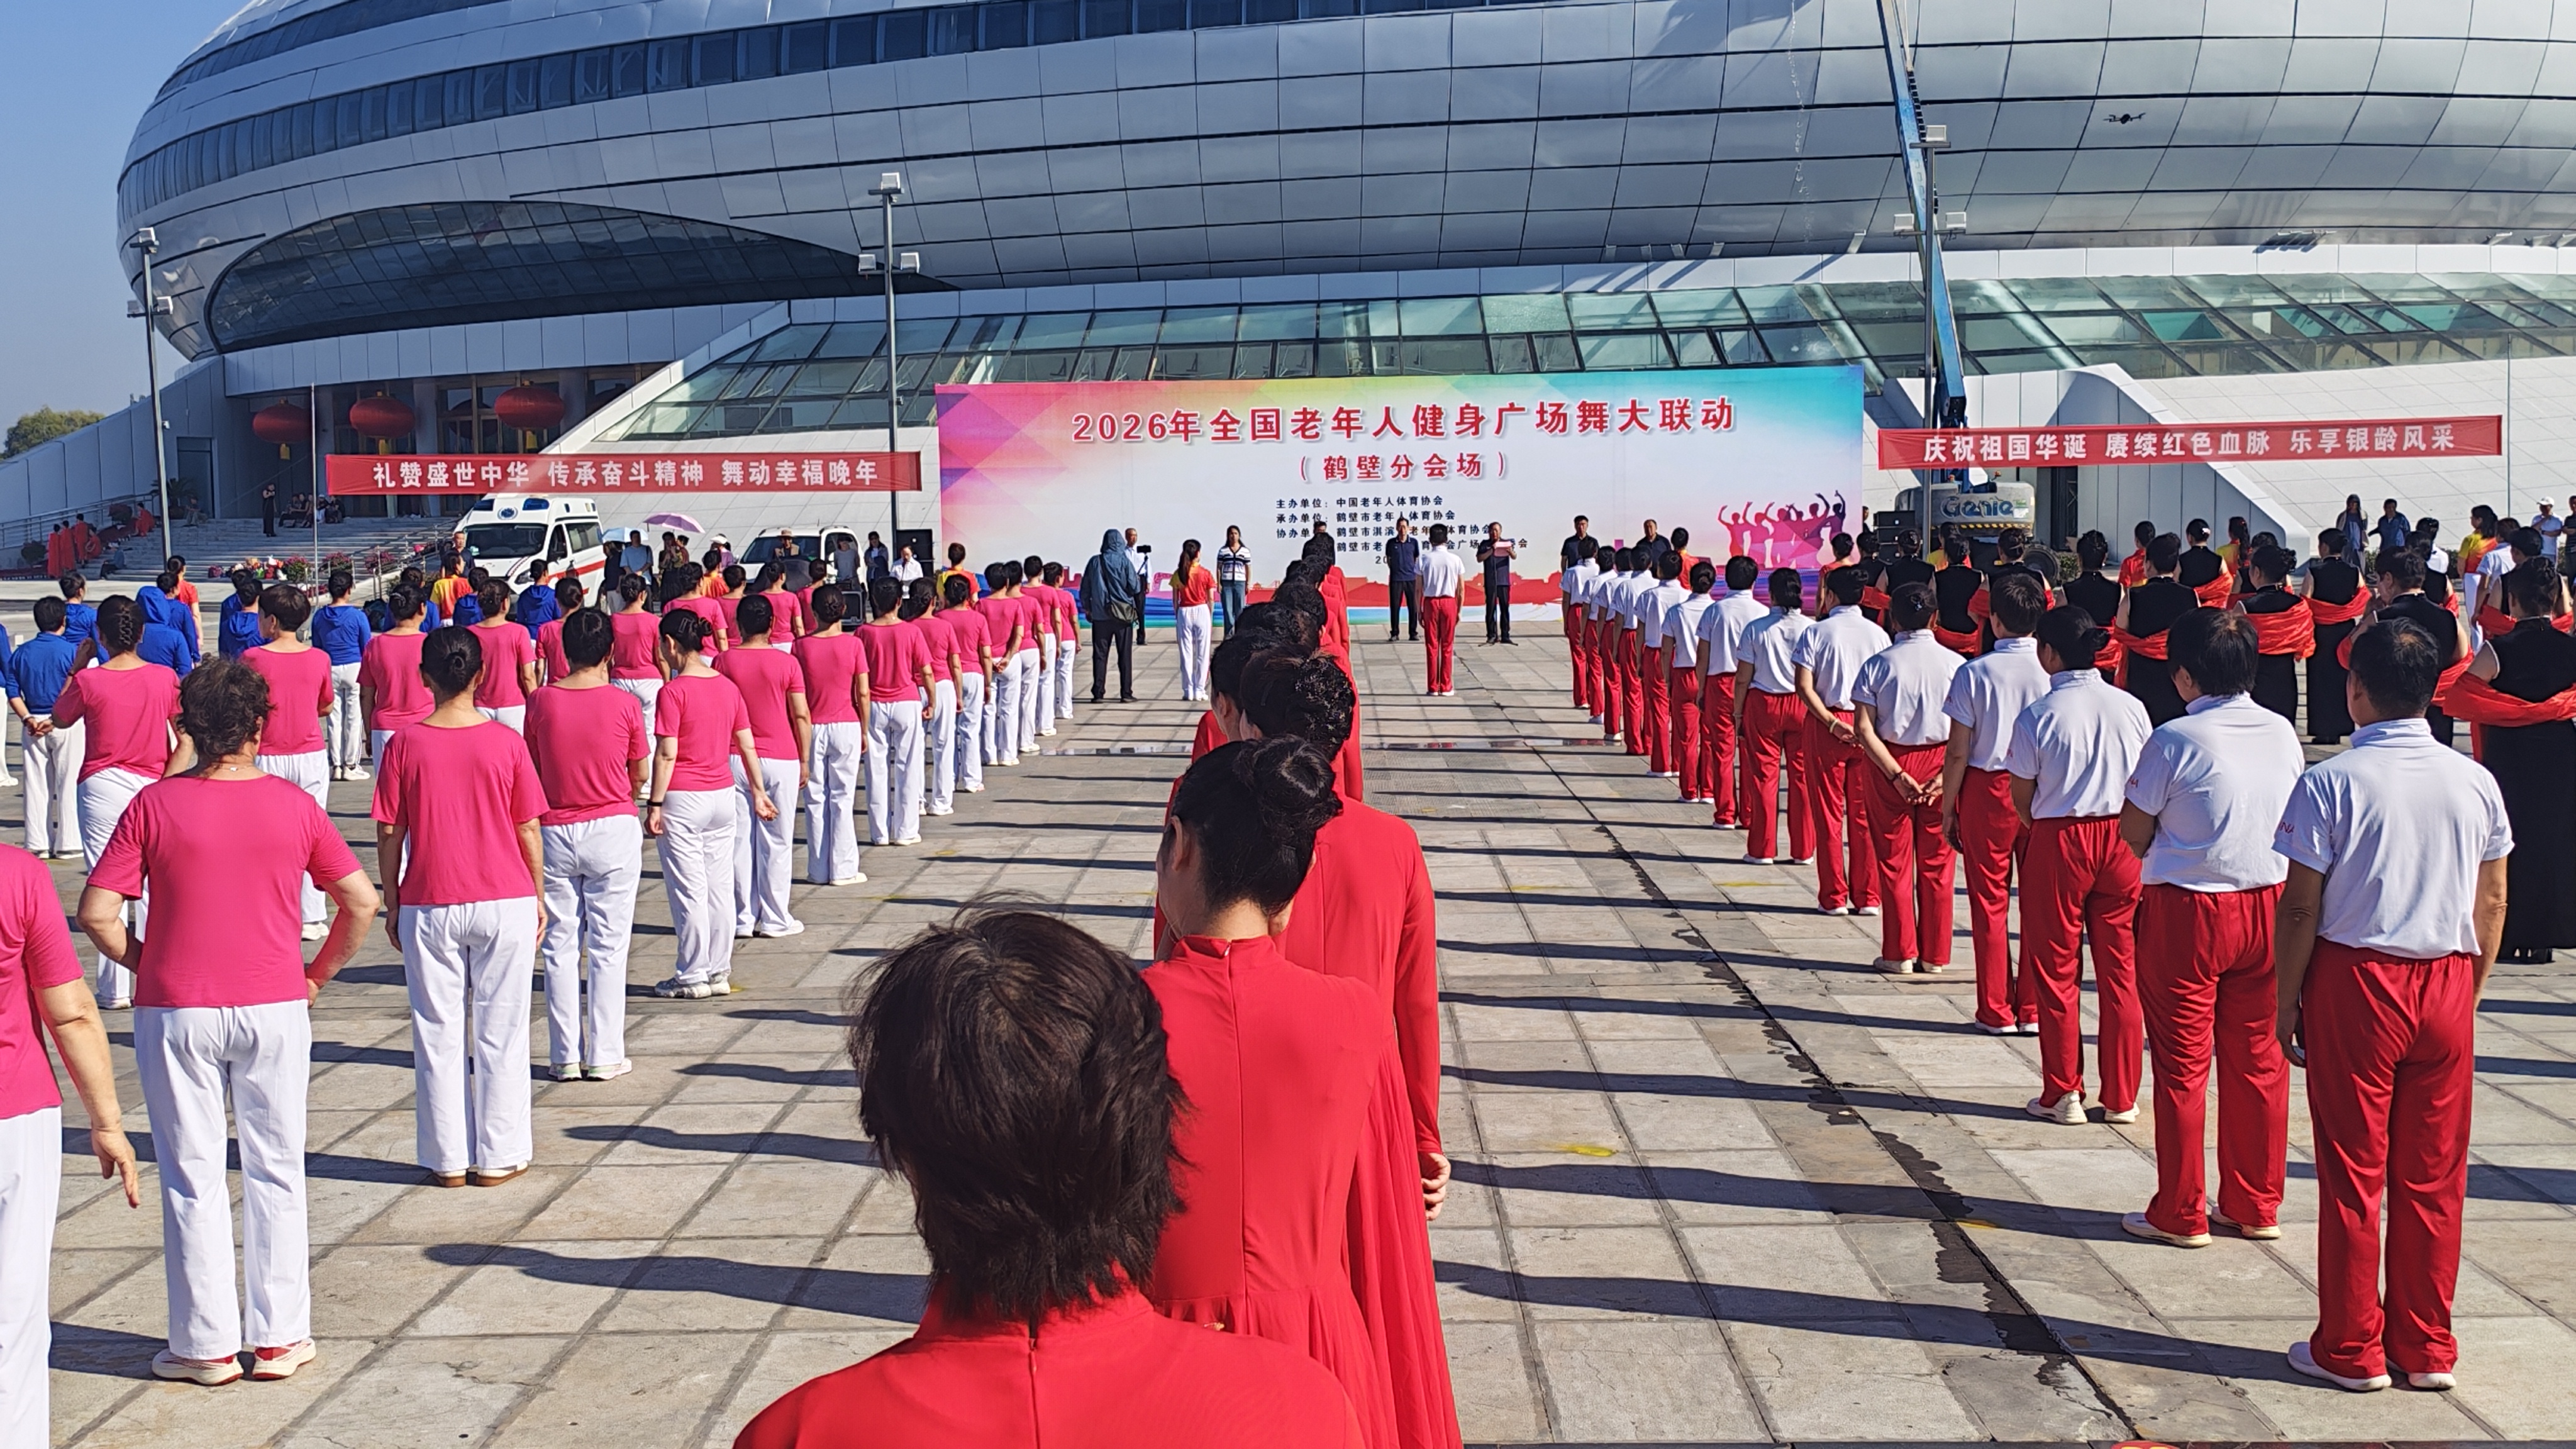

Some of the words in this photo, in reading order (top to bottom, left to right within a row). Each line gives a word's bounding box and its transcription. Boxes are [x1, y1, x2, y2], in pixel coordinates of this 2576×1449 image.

[1072, 397, 1733, 442] 2026年全国老年人健身广场舞大联动
[1924, 433, 2087, 462] 庆祝祖国华诞
[2105, 430, 2270, 458] 赓续红色血脉
[2290, 424, 2455, 454] 乐享银龄风采
[374, 461, 530, 488] 礼赞盛世中华
[548, 460, 703, 487] 传承奋斗精神
[721, 459, 878, 486] 舞动幸福晚年
[1300, 452, 1505, 480] （鹤壁分会场）
[1941, 496, 2014, 518] Genie
